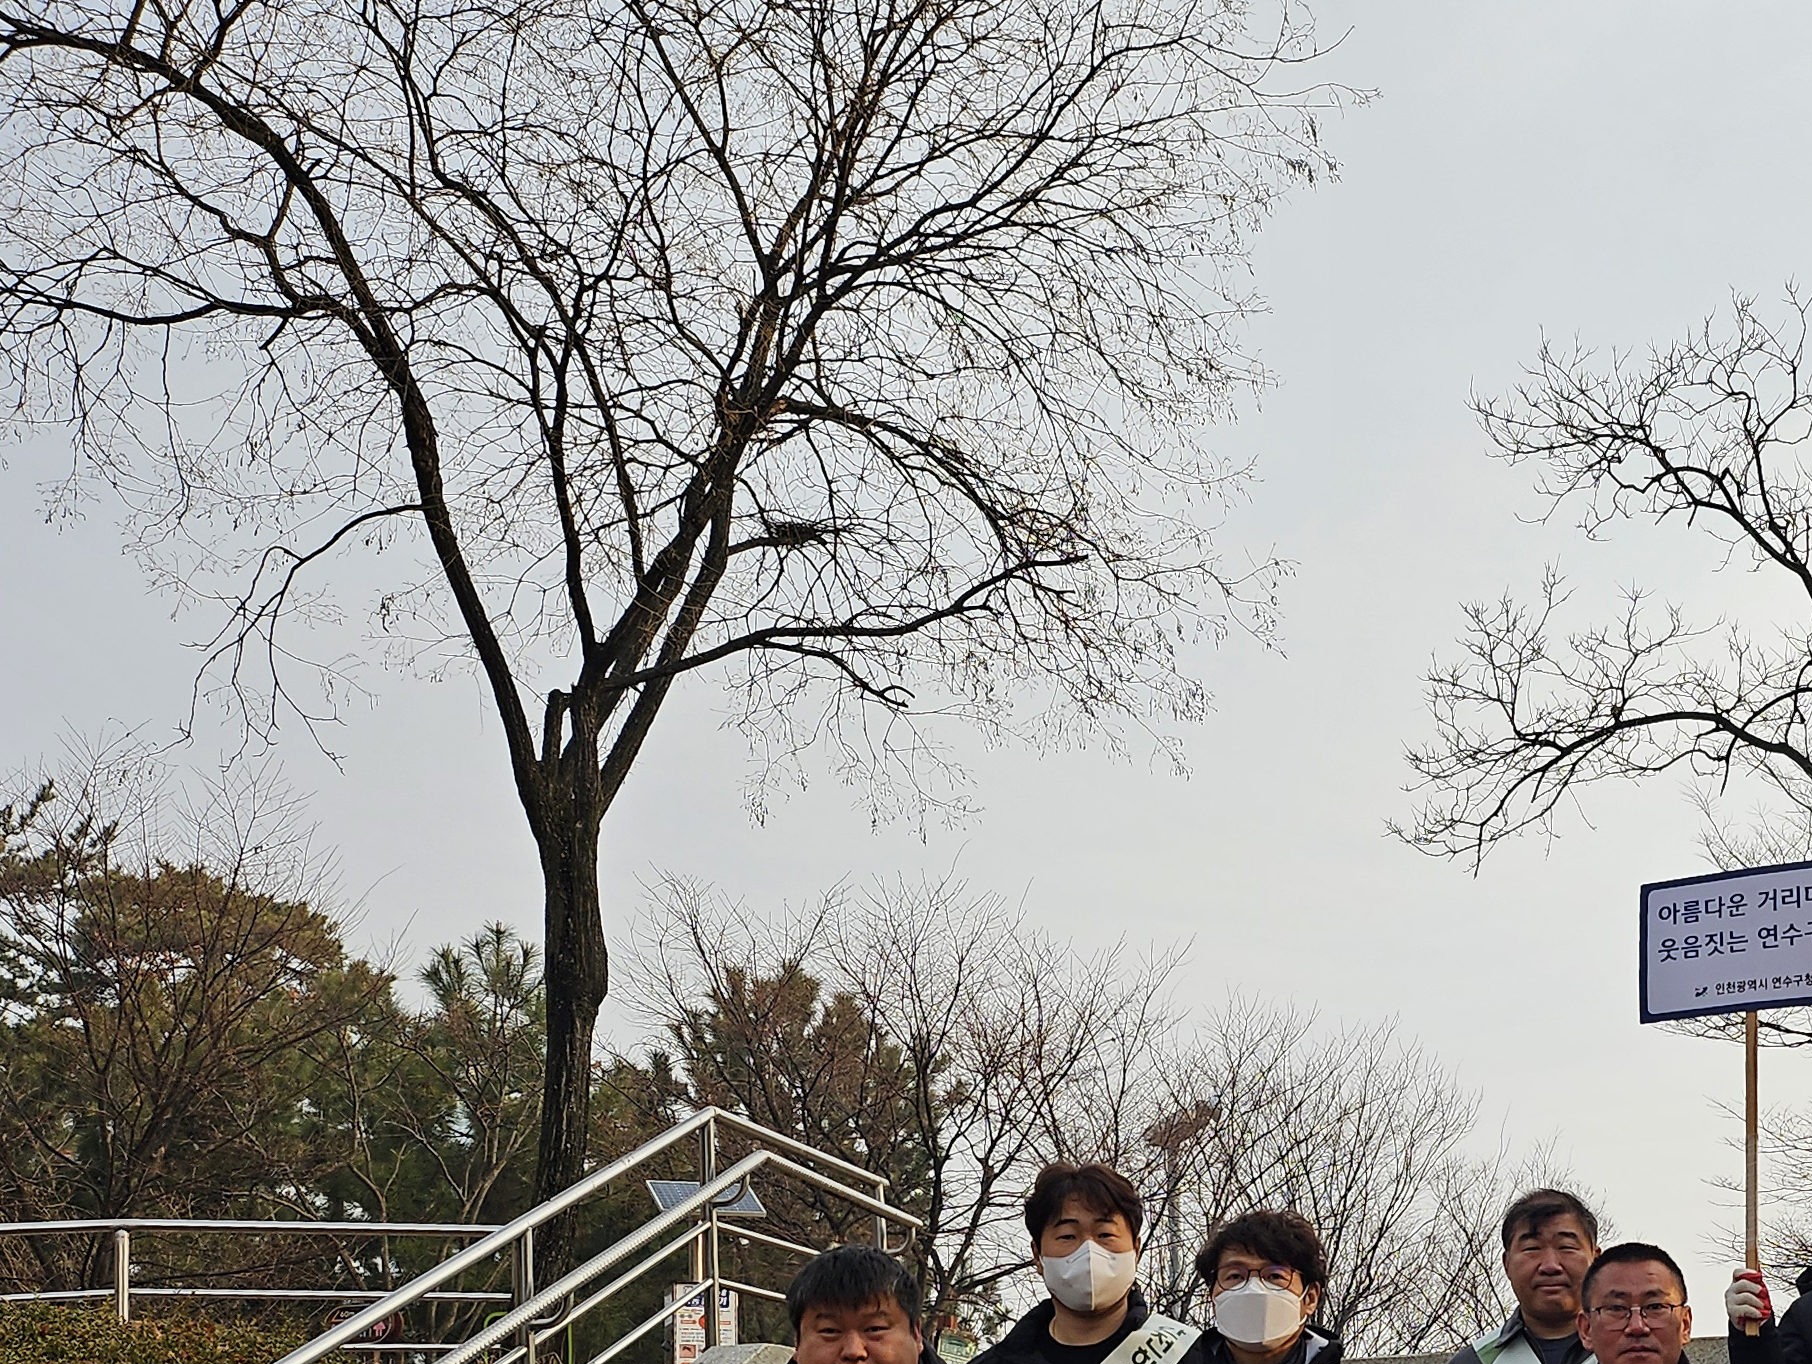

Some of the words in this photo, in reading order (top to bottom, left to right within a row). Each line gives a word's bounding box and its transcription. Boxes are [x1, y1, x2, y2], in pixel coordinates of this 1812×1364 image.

[1658, 893, 1748, 925] 아름다운
[1657, 930, 1749, 963] 웃음짓는
[1715, 977, 1768, 995] 인천광역시
